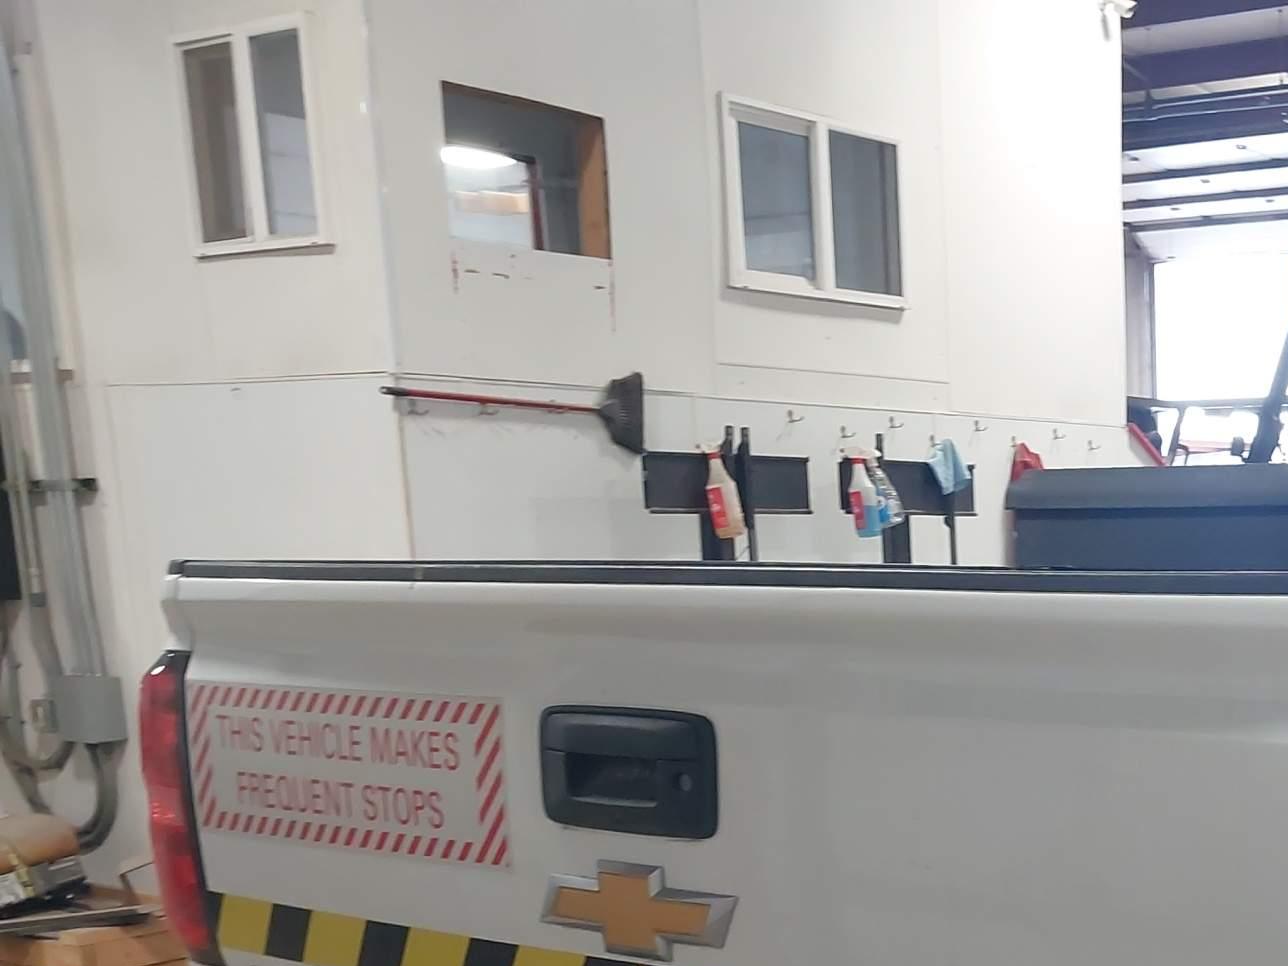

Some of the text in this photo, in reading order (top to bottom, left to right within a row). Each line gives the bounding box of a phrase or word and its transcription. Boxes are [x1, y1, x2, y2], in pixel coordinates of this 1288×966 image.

[215, 714, 460, 771] THIS VEHICLE MAKES
[236, 771, 445, 829] FREQUENT STOPS
